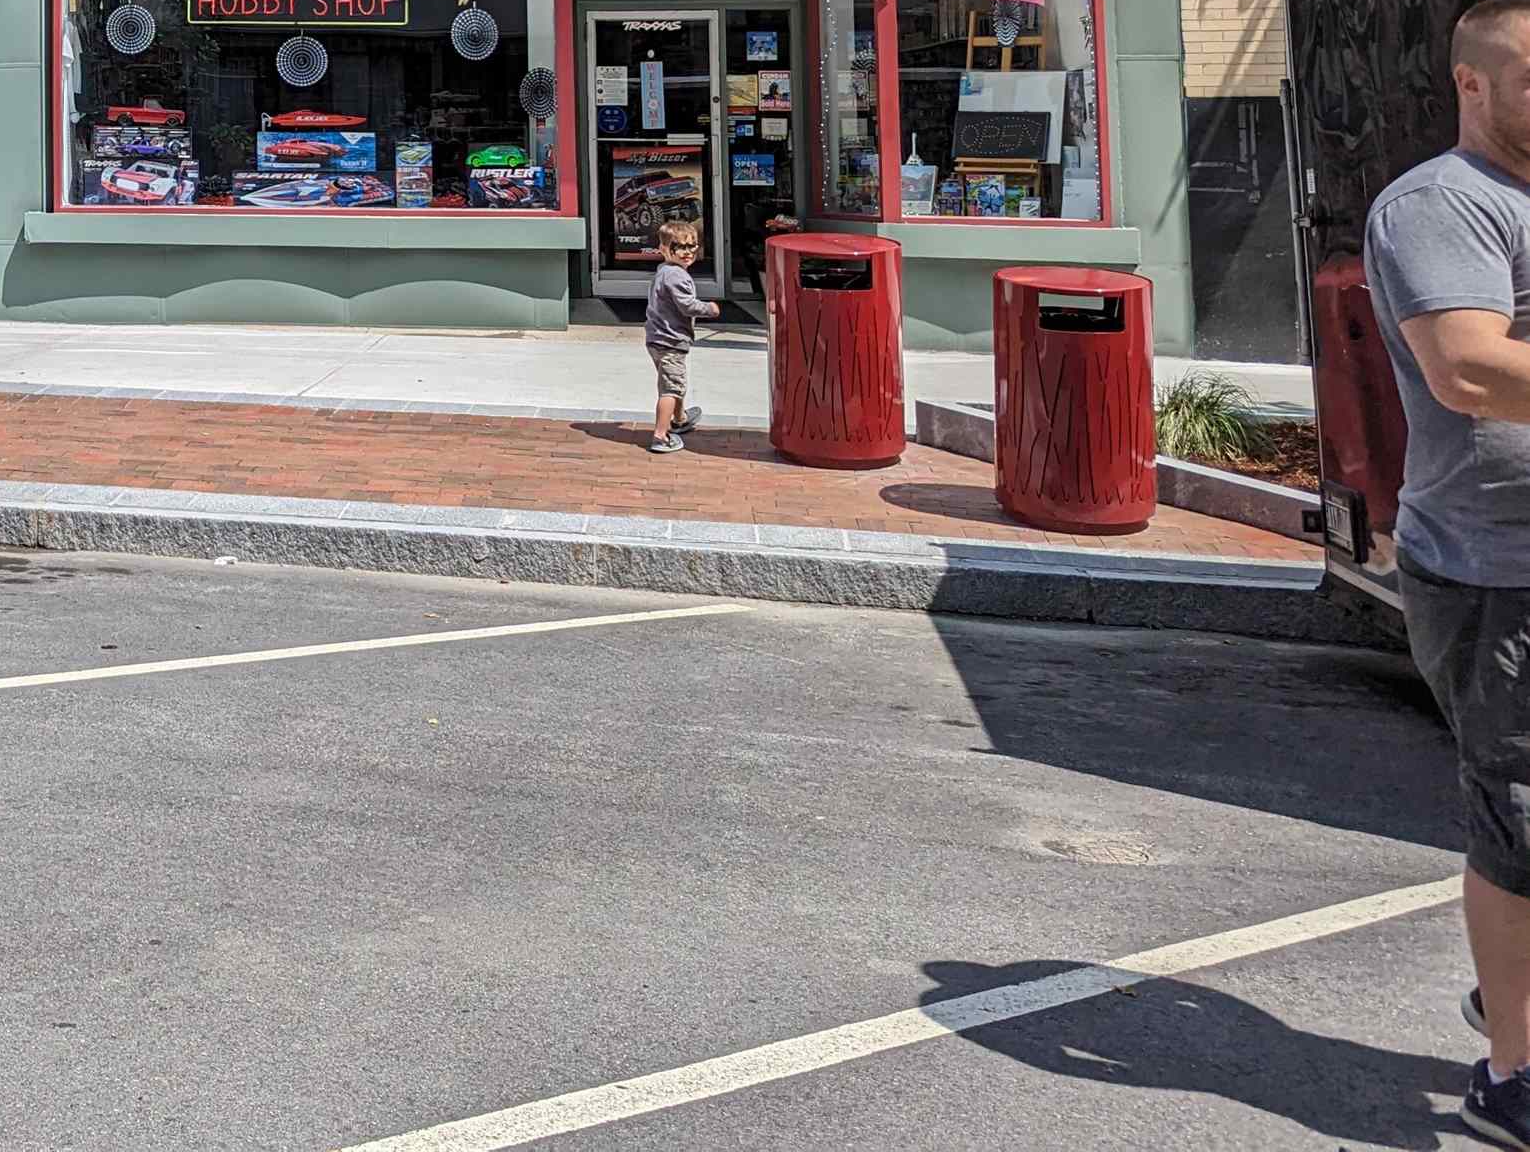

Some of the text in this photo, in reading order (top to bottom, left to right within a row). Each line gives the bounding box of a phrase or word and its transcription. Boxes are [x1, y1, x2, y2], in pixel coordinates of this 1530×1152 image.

[622, 21, 682, 31] TRAXXAS
[960, 117, 1044, 151] OPEN
[233, 172, 319, 180] SPARTAN
[470, 168, 535, 178] RUSTLER
